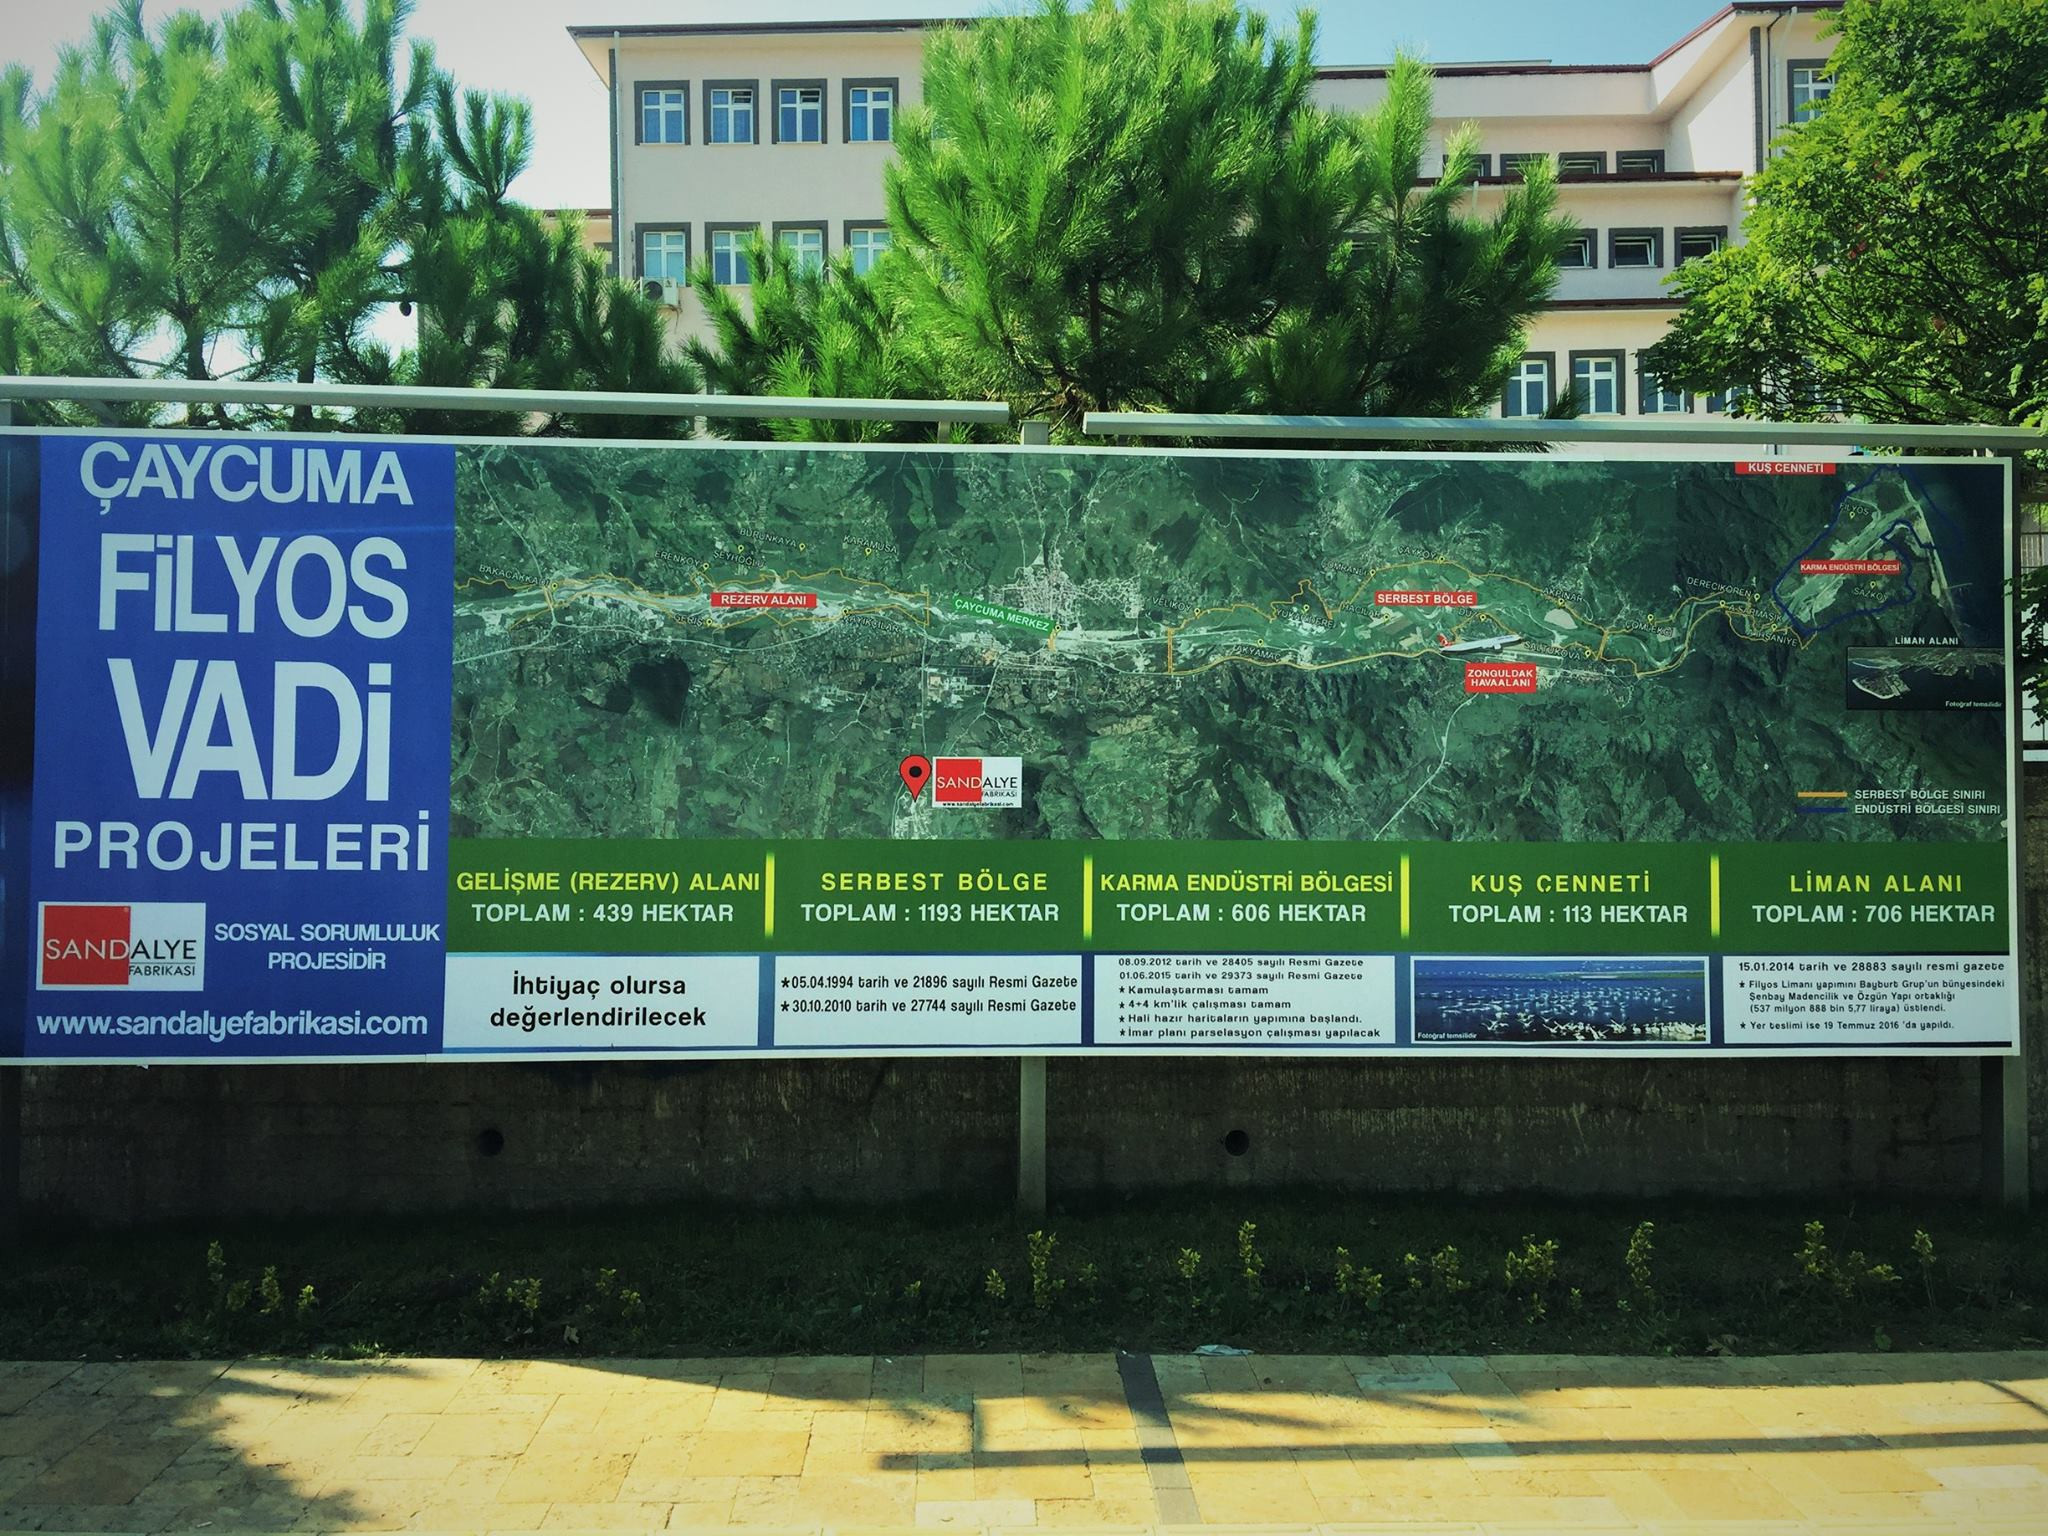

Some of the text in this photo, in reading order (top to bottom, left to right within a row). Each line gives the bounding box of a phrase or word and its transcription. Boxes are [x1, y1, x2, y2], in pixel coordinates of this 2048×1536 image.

[1748, 462, 1772, 474] KUŞ
[80, 441, 414, 516] ÇAYCUMA
[1800, 563, 1828, 571] KARMA
[721, 594, 807, 605] REZERV ALANI
[1377, 592, 1474, 605] SERBEST BÖLGE
[954, 599, 1051, 632] ÇAYCUMA MERKEZ
[1929, 636, 1959, 645] ALANI
[1467, 669, 1534, 678] ZONGULDAK
[1471, 678, 1531, 687] HAVAALANI
[936, 776, 1018, 789] SANDALYE
[1854, 787, 1986, 800] SERBEST BÖLGE SINIRI
[1854, 802, 1912, 814] ENDÜSTRİ
[1968, 804, 2001, 814] SINIRI
[457, 868, 759, 895] GELİŞME (REZERV) ALANI
[822, 869, 1047, 891] SERBEST BÖLGE
[1101, 870, 1392, 892] KARMA ENDÜSTRİ BÖLGESİ
[1472, 875, 1522, 897] KUŞ
[1791, 870, 1961, 892] LİMAN ALANI
[472, 904, 733, 922] TOPLAM 439 HEKTAR
[801, 904, 1059, 922] TOPLAM 1193 HEKTAR
[1116, 904, 1366, 922] TOPLAM 606 HEKTAR
[1448, 905, 1687, 923] TOPLAM 113 HEKTAR
[1752, 905, 1994, 923] TOPLAM 706 HEKTAR
[215, 923, 440, 941] SOSYAL SORUMLULUK
[46, 938, 197, 960] SANDALYE
[1117, 957, 1173, 967] 08.09.2012
[1175, 957, 1203, 967] tarih
[1205, 959, 1219, 967] ve
[1221, 957, 1254, 967] 28405
[1288, 957, 1322, 967] Resmi
[1324, 958, 1364, 967] Gazete
[1738, 961, 1795, 972] 15.01.2014
[1798, 961, 1829, 972] tarih
[1832, 963, 1848, 972] ve
[1851, 961, 1887, 972] 28883
[1926, 961, 1960, 972] resmi
[1962, 962, 2005, 974] gazete
[129, 965, 196, 977] FABRIKASI
[1118, 970, 1172, 981] 01.06.2015
[1174, 971, 1202, 980] tarih
[1204, 972, 1218, 980] ve
[1287, 970, 1321, 981] Resmi
[1323, 971, 1364, 981] Gazete
[513, 970, 685, 1000] İhtiyaç olursa
[791, 975, 854, 990] 05.04.1994
[857, 975, 890, 989] tarih
[893, 978, 909, 989] ve
[912, 974, 948, 989] 21896
[988, 975, 1028, 989] Resmi
[1031, 974, 1078, 989] Gazete
[1748, 979, 1779, 992] Filyos
[1781, 979, 1814, 989] Limanı
[1859, 979, 1899, 992] Bayburt
[1901, 979, 1940, 991] Grup'un
[1227, 986, 1269, 995] tamam
[1788, 991, 1840, 1001] Madencilik
[1842, 993, 1854, 1001] ve
[1856, 990, 1888, 1004] Özgün
[791, 998, 852, 1013] 30.10.2010
[855, 999, 888, 1013] tarih
[891, 1001, 907, 1013] ve
[910, 998, 947, 1012] 27744
[987, 998, 1027, 1012] Resmi
[1030, 998, 1077, 1012] Gazete
[1153, 999, 1188, 1009] km'lik
[1250, 1000, 1292, 1009] tamam
[1749, 1003, 1771, 1014] (537
[1773, 1004, 1807, 1016] milyon
[1808, 1003, 1827, 1013] 888
[1829, 1003, 1846, 1013] bin
[490, 1005, 706, 1032] değerlendirilecek
[1127, 1013, 1151, 1023] Hali
[37, 1010, 427, 1042] www.sandalyefabrikasi.com
[1749, 1020, 1767, 1030] Yer
[1768, 1021, 1804, 1030] teslimi
[1805, 1022, 1821, 1030] ise
[1823, 1020, 1834, 1030] 19
[1836, 1020, 1876, 1030] Temmuz
[1878, 1020, 1900, 1030] 2016
[1190, 1027, 1263, 1040] parselasyon
